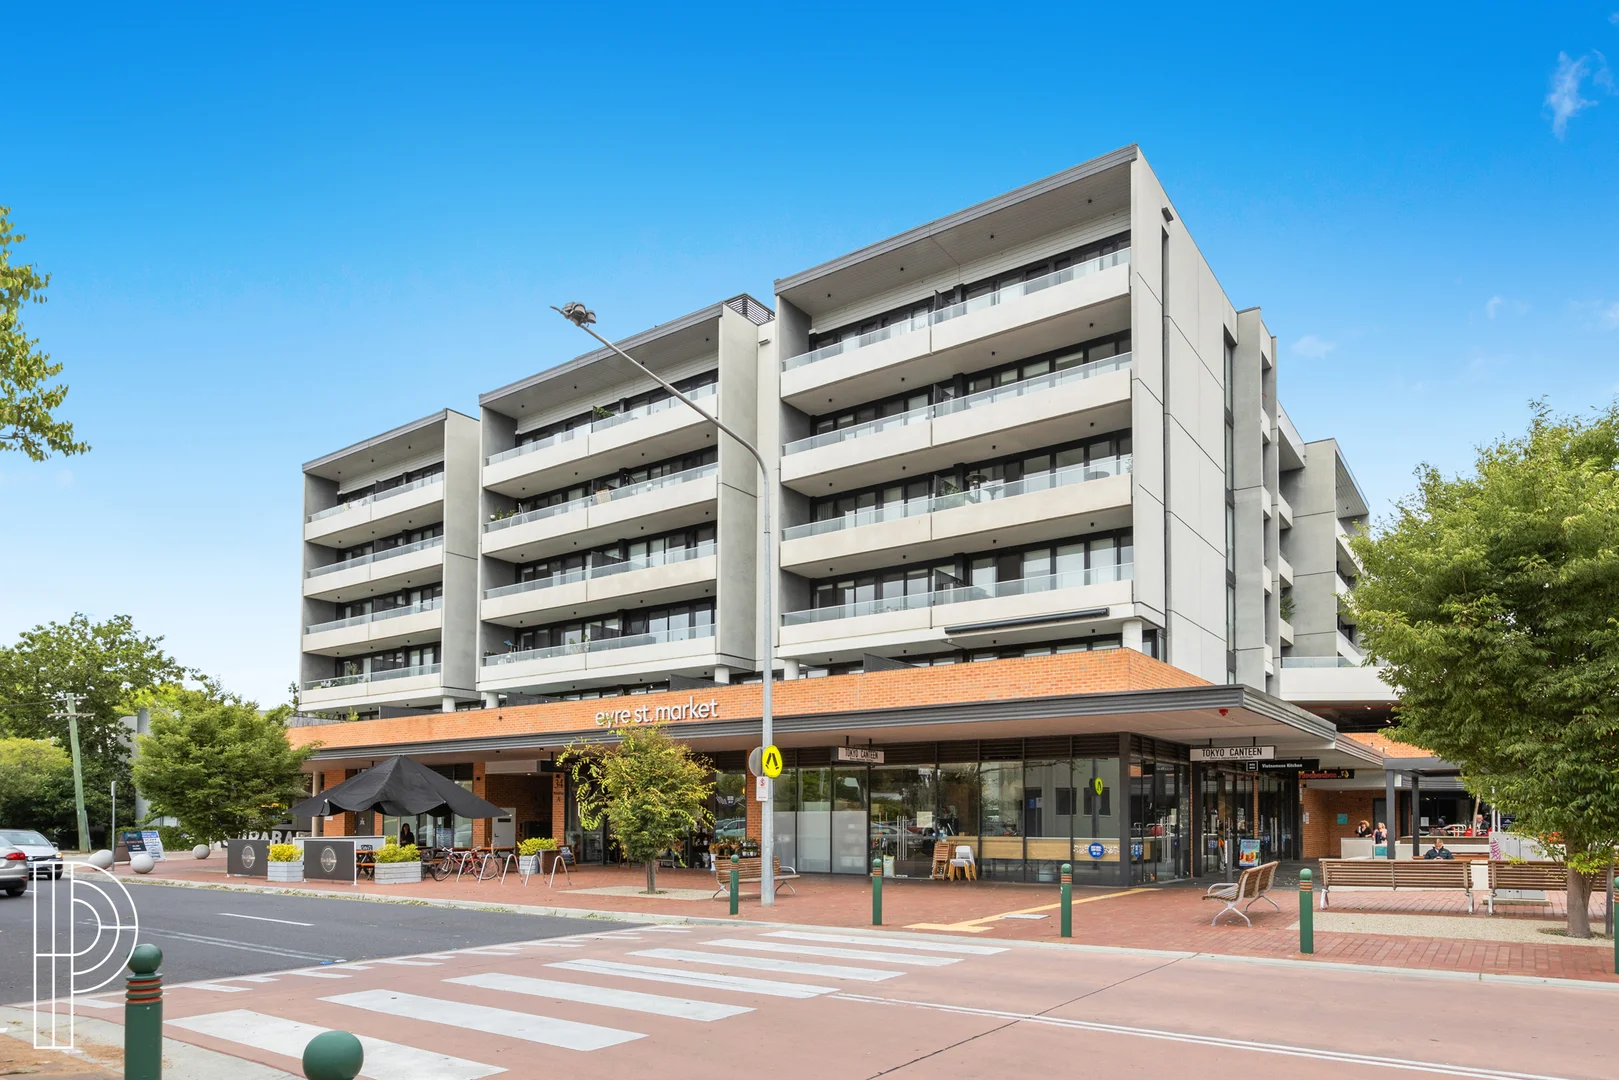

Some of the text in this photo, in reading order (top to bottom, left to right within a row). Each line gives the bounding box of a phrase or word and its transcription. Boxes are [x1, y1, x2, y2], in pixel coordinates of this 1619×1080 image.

[595, 696, 718, 728] eyre st. market
[845, 748, 879, 759] TOKYO CANTEEN
[1202, 748, 1262, 757] TOKYO CANTEEN
